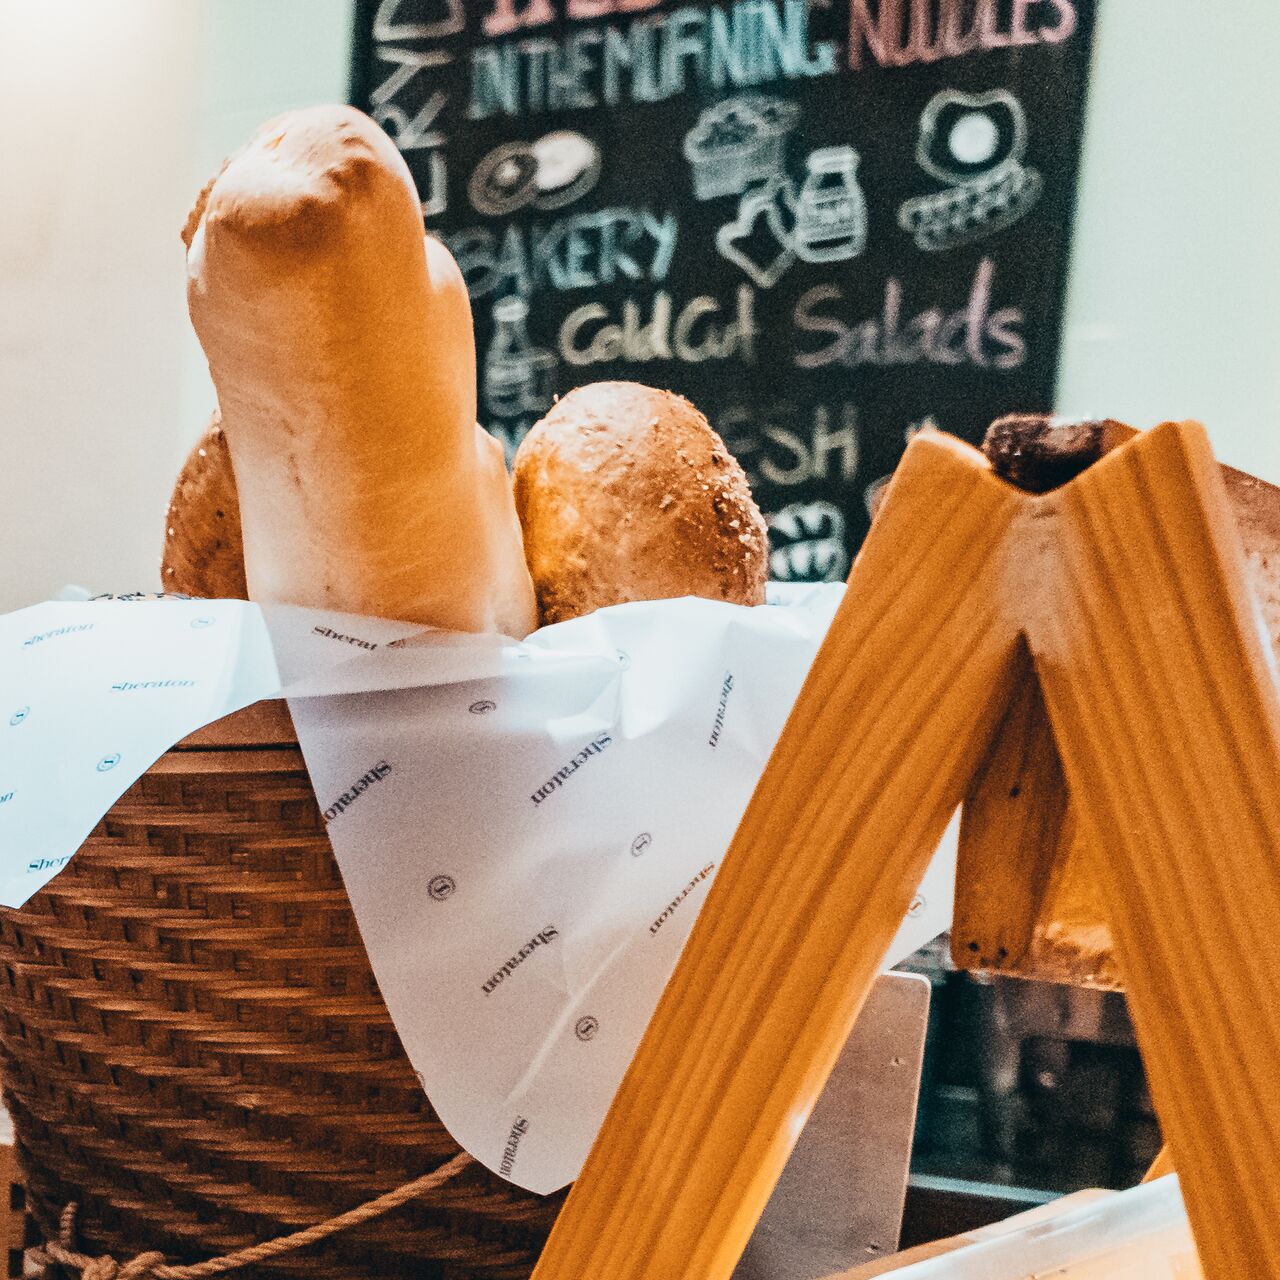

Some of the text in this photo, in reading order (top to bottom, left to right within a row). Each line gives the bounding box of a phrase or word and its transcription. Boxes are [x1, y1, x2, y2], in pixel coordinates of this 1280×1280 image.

[793, 257, 1027, 369] Salads
[530, 731, 613, 807] Sheraton
[481, 924, 559, 996] Sheraton
